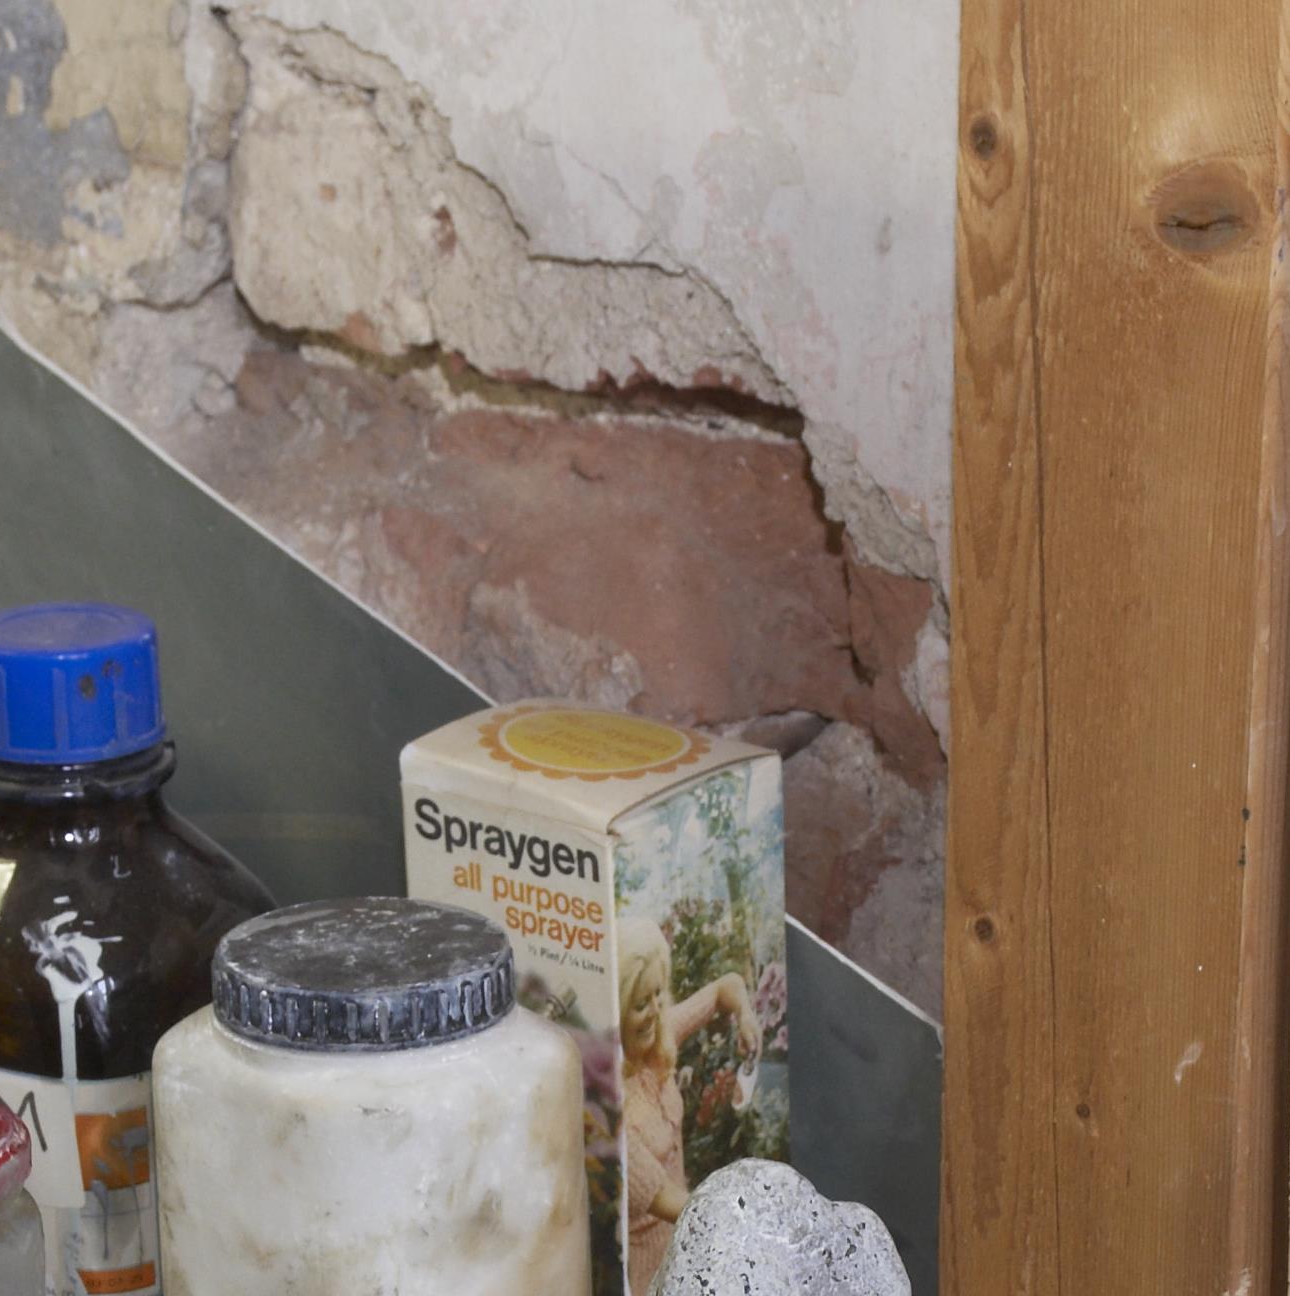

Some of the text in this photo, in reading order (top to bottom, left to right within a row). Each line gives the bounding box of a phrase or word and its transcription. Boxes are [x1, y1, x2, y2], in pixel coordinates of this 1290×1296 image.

[415, 798, 599, 882] Spraygen
[454, 863, 602, 924] all purpose
[506, 906, 604, 951] sprayer
